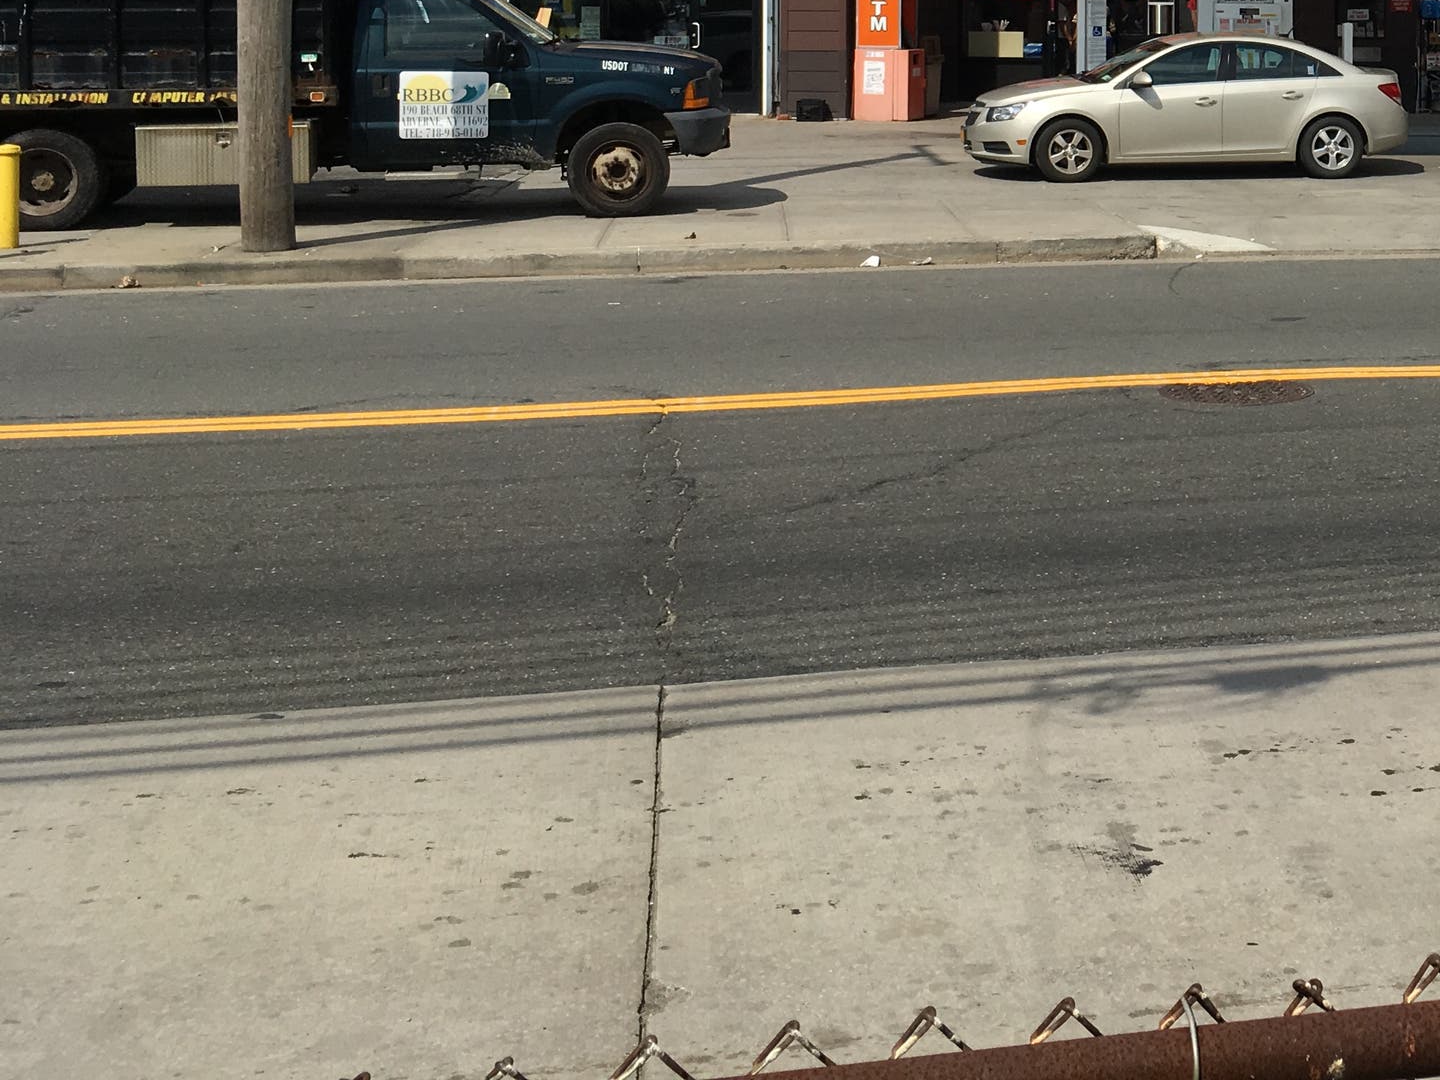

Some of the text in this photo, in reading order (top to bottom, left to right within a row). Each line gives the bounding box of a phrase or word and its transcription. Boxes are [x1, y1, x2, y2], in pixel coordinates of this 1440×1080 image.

[602, 60, 628, 71] USDOT
[663, 66, 675, 76] NY
[1, 94, 10, 104] &
[403, 88, 455, 102] RBBC
[402, 105, 487, 115] 190 BEACH 68TH ST
[447, 116, 458, 126] NY
[463, 117, 488, 126] 11692
[404, 128, 423, 137] TEL:
